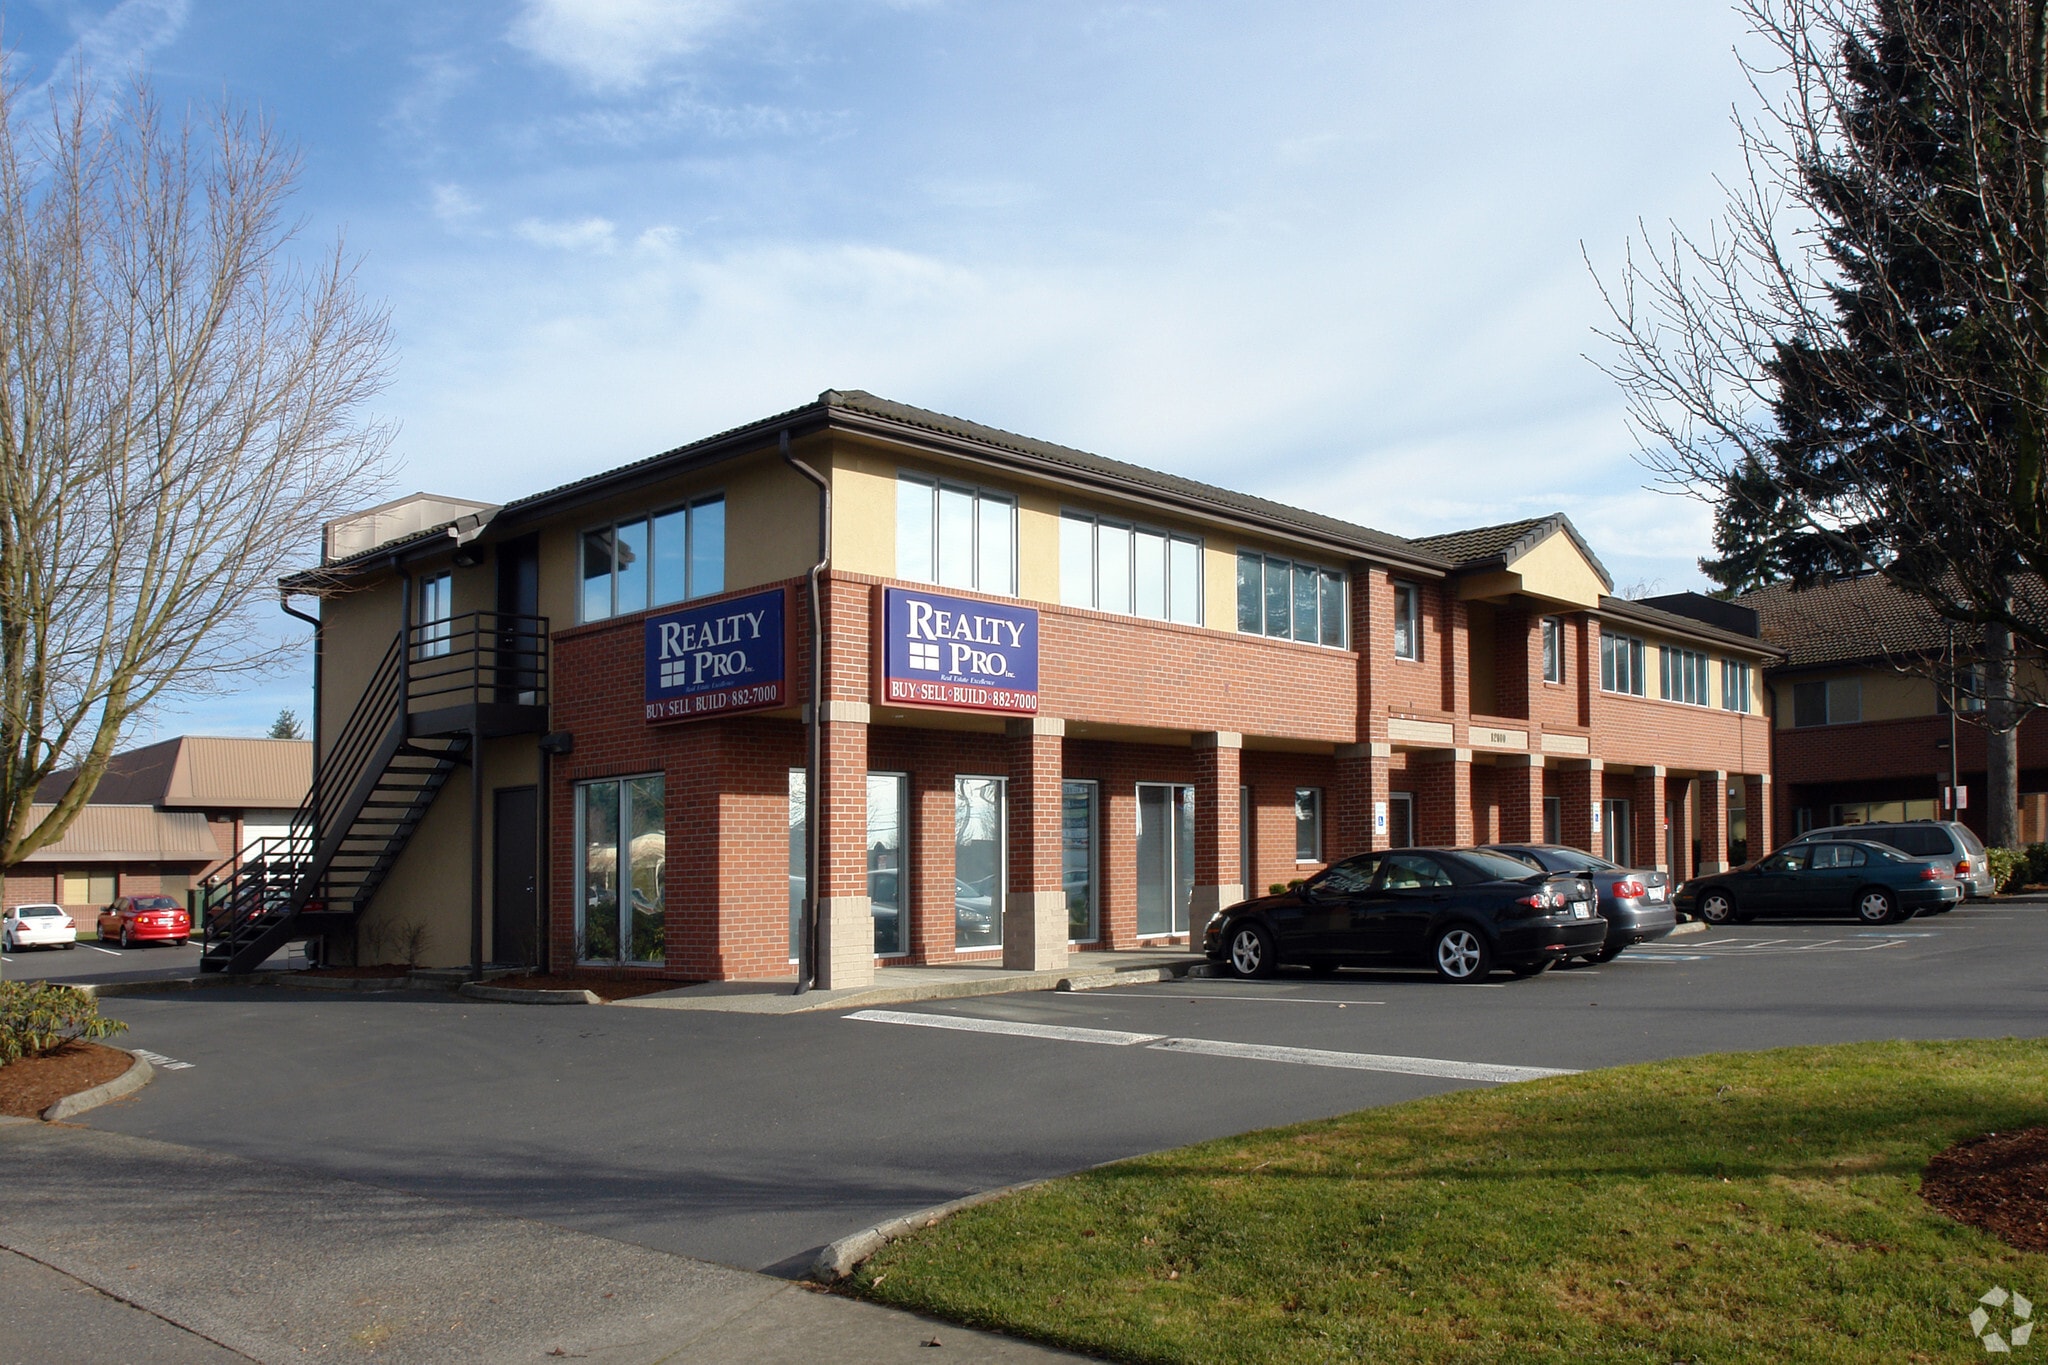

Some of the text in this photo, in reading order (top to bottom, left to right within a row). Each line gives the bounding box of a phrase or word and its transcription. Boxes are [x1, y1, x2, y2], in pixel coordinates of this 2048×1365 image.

[658, 609, 765, 660] REALTY
[906, 599, 1025, 648] REALTY
[693, 650, 746, 685] PRO
[948, 642, 1007, 676] PRO
[646, 703, 666, 719] BUY
[668, 699, 691, 716] SELL
[695, 692, 727, 712] BUILD
[731, 684, 777, 706] 882-7000
[892, 681, 1037, 710] BUY SELL BUILD 882-7000
